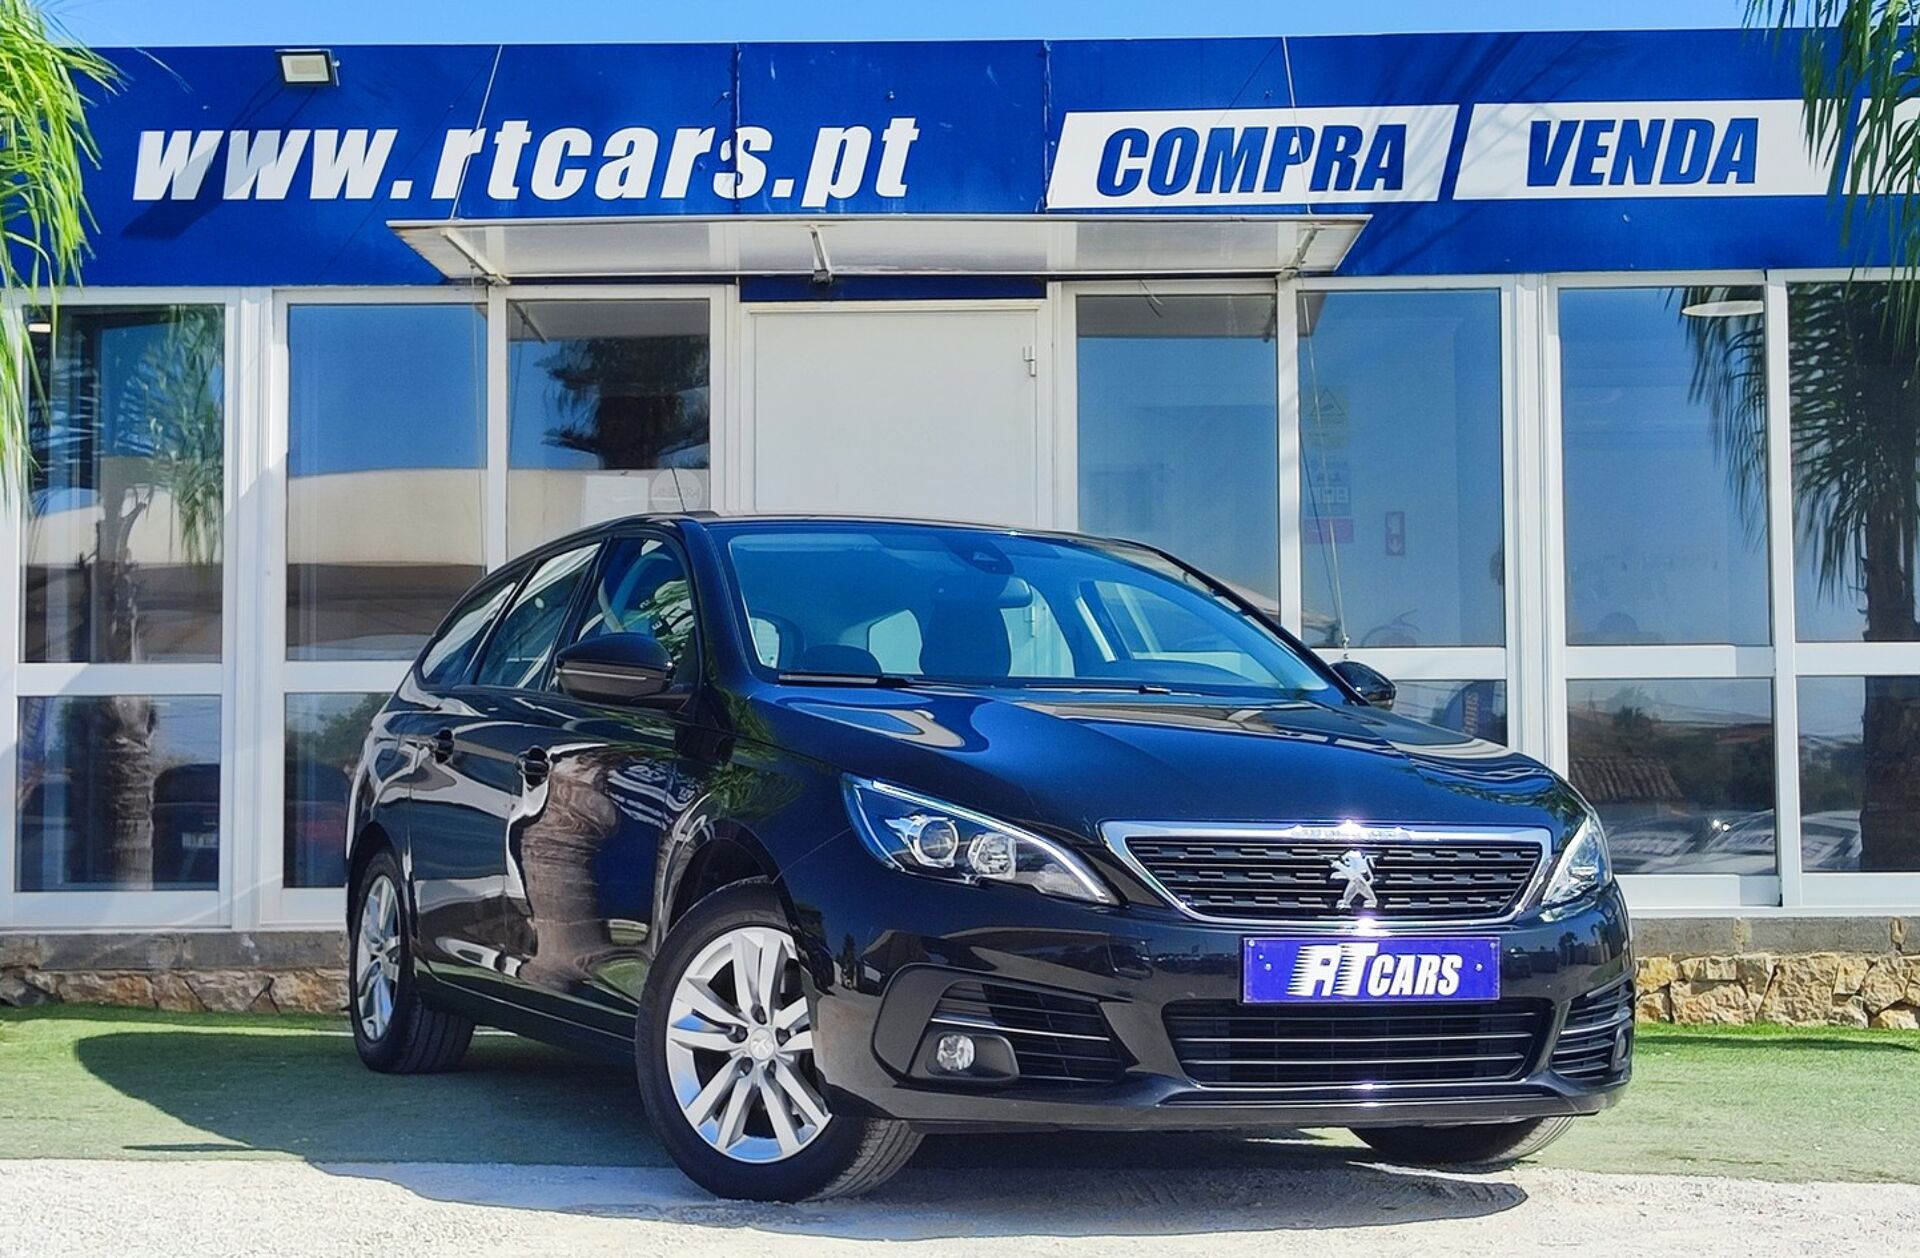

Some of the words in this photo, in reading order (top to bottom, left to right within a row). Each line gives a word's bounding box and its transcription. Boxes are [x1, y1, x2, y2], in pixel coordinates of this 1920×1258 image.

[132, 116, 920, 207] www.rtcars.pt
[1096, 124, 1407, 197] COMPRA
[1527, 117, 1759, 187] VENDA
[1367, 953, 1463, 997] CARS
